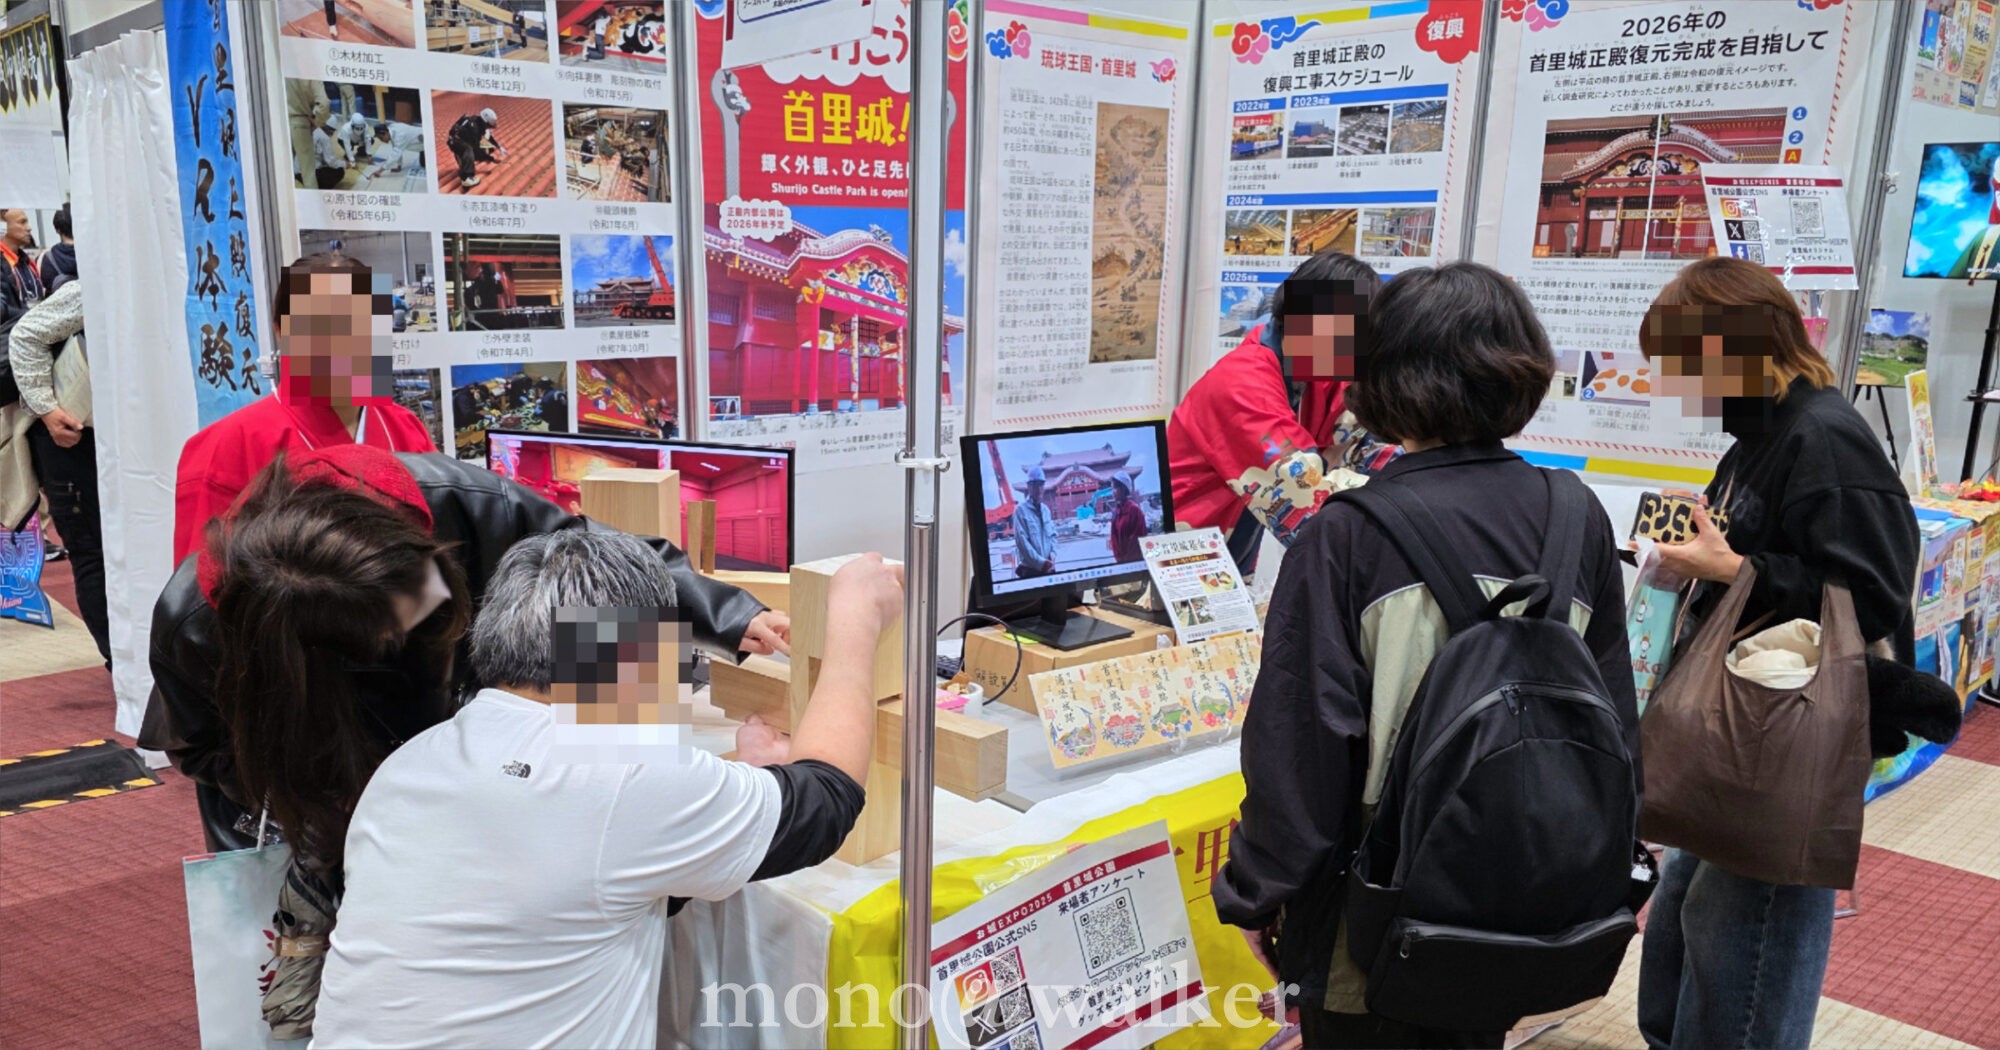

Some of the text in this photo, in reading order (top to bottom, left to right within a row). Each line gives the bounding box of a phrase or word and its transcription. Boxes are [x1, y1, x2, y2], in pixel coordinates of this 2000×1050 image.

[1426, 19, 1465, 42] 復興
[1621, 10, 1727, 38] 2026年の
[1041, 49, 1137, 79] 琉球王国・首里城
[1293, 43, 1386, 68] 首里城正殿の
[1529, 30, 1830, 73] 首里城正殿復元完成を目指して
[1263, 65, 1414, 94] 復興工事スケジュール
[1787, 151, 1798, 162] A
[771, 183, 908, 199] Shurijo Castle Park is open!
[976, 860, 1116, 940] お城EXPO2025 首里城公園
[1058, 868, 1145, 916] 来場者アンケート
[936, 919, 1037, 981] 首里城公園公式SNS
